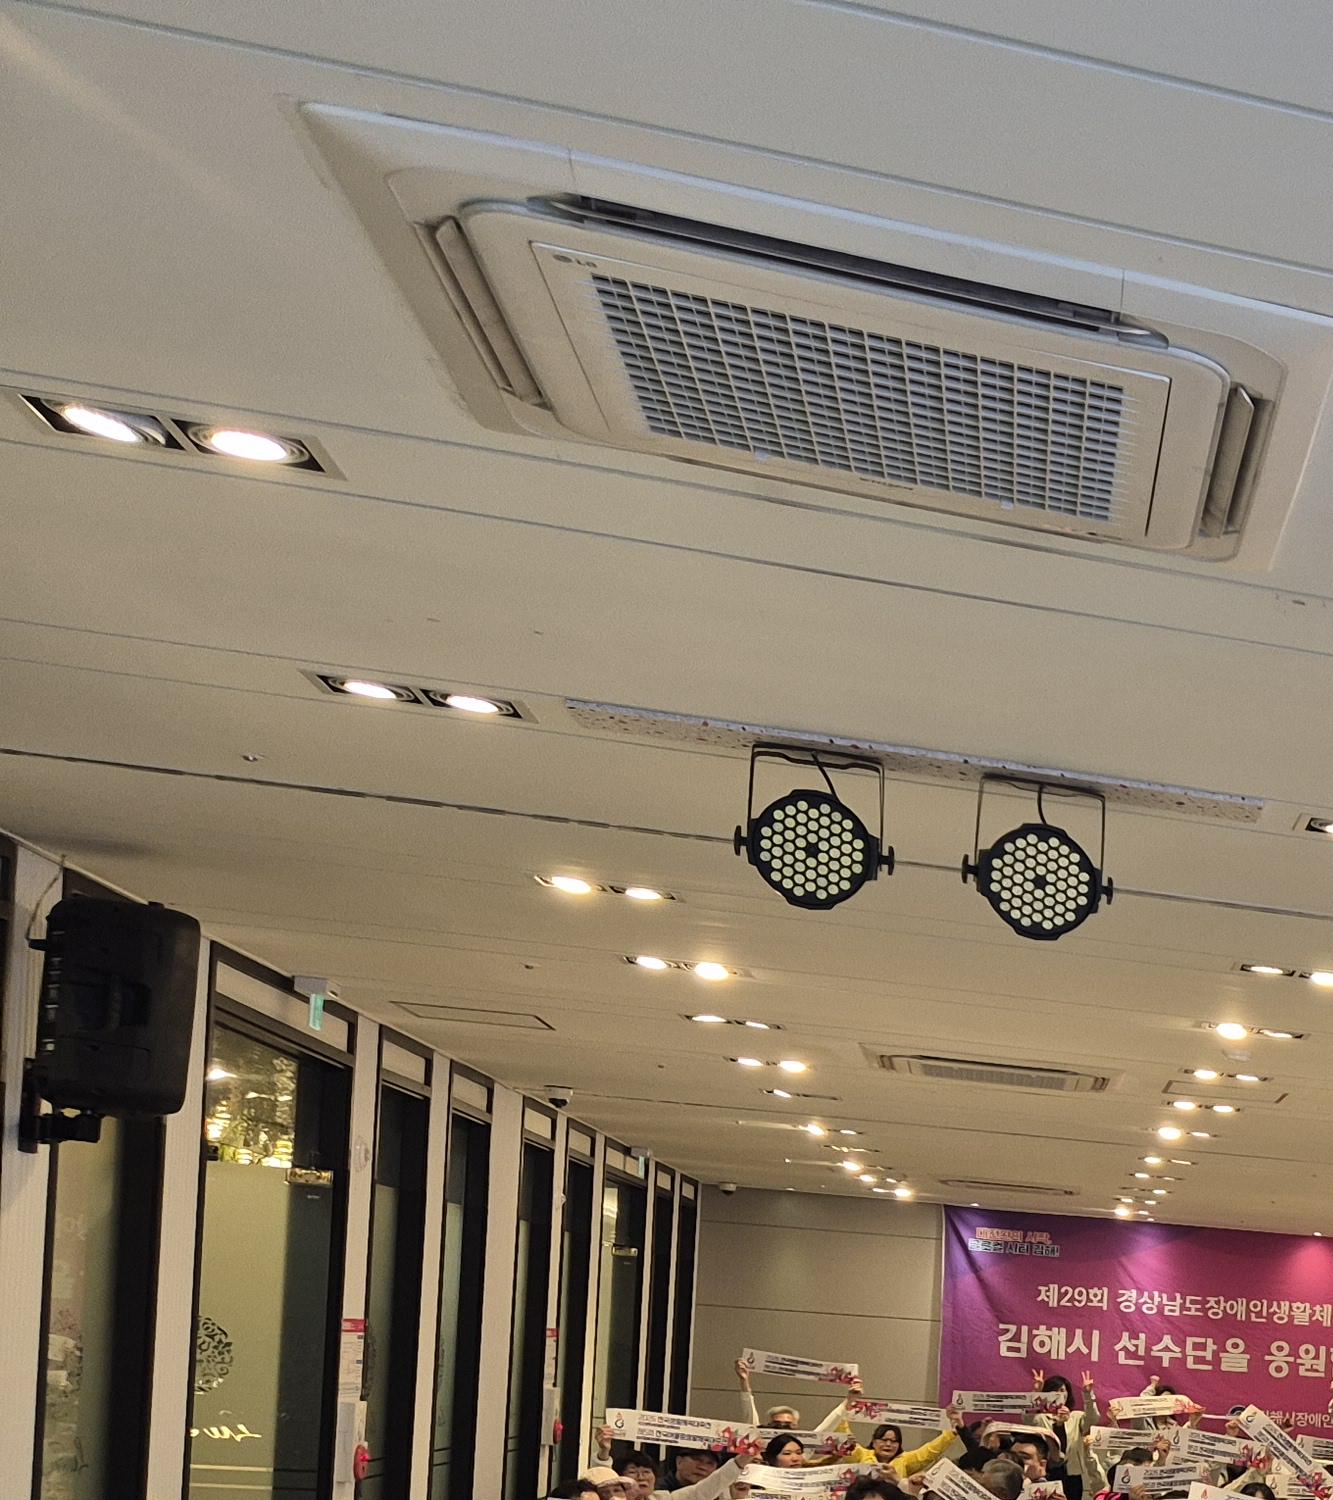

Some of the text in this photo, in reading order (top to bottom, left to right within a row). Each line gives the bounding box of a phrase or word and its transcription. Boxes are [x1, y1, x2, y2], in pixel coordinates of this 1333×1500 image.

[1037, 1284, 1109, 1311] 제29회
[998, 1323, 1101, 1362] 김해시
[1114, 1331, 1251, 1373] 선수단을
